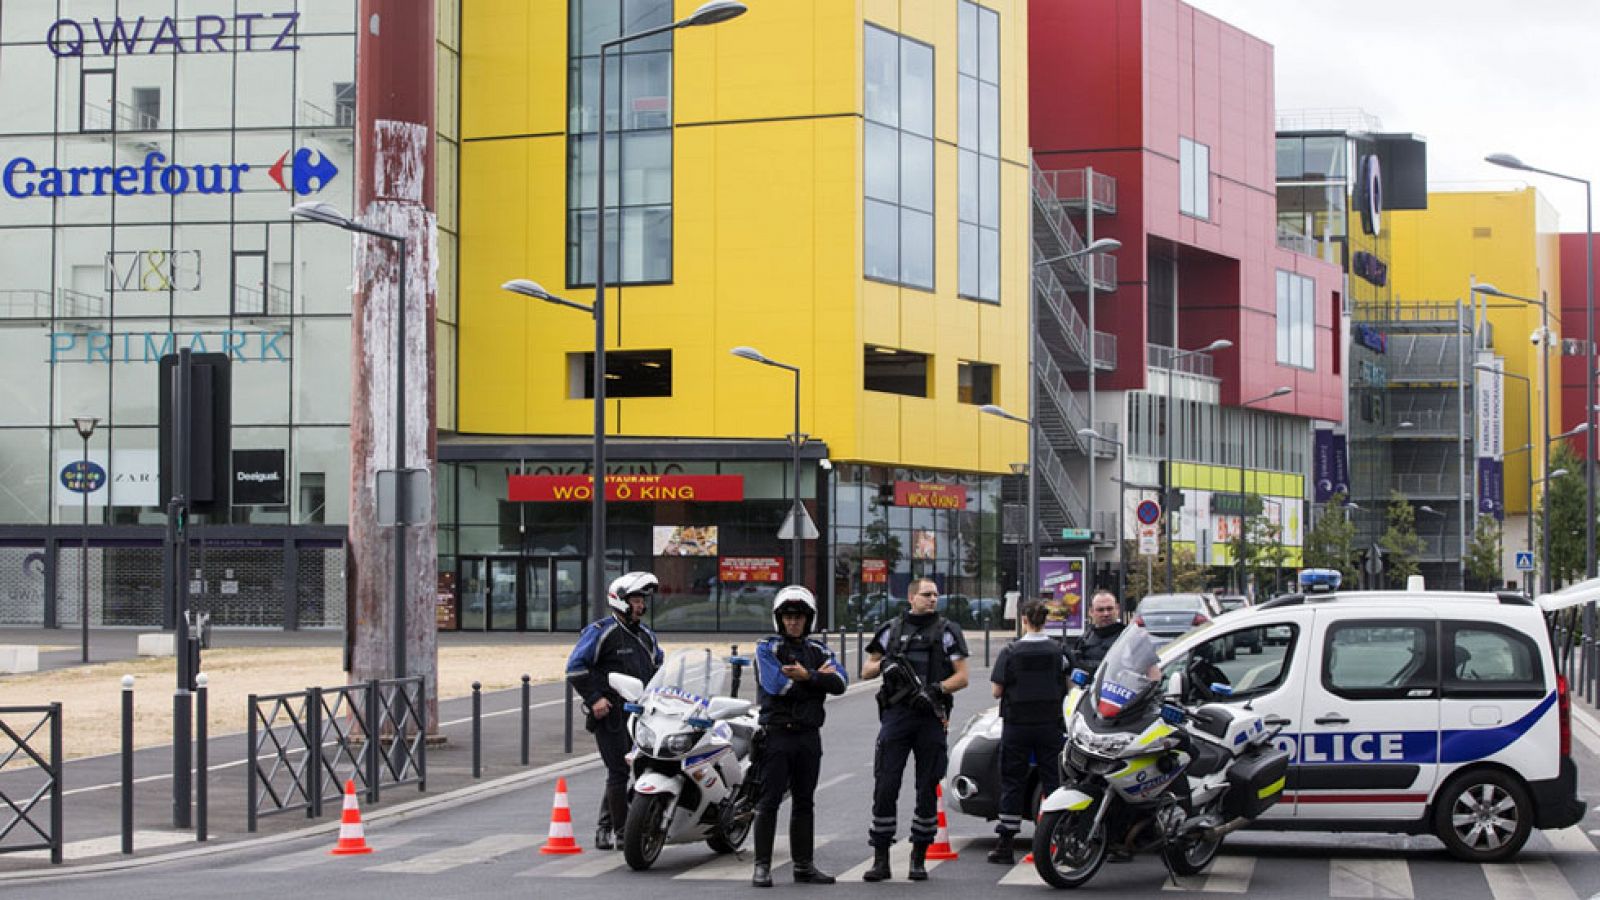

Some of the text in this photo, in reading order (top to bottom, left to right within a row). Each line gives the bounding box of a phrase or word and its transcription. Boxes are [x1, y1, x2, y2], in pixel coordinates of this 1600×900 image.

[46, 12, 301, 57] QWARTZ
[3, 151, 250, 198] Carrefour
[51, 330, 288, 364] PRIMARK
[553, 486, 594, 499] WO
[641, 486, 694, 499] KING
[1101, 682, 1132, 699] POLICE
[1271, 735, 1404, 762] OLICE
